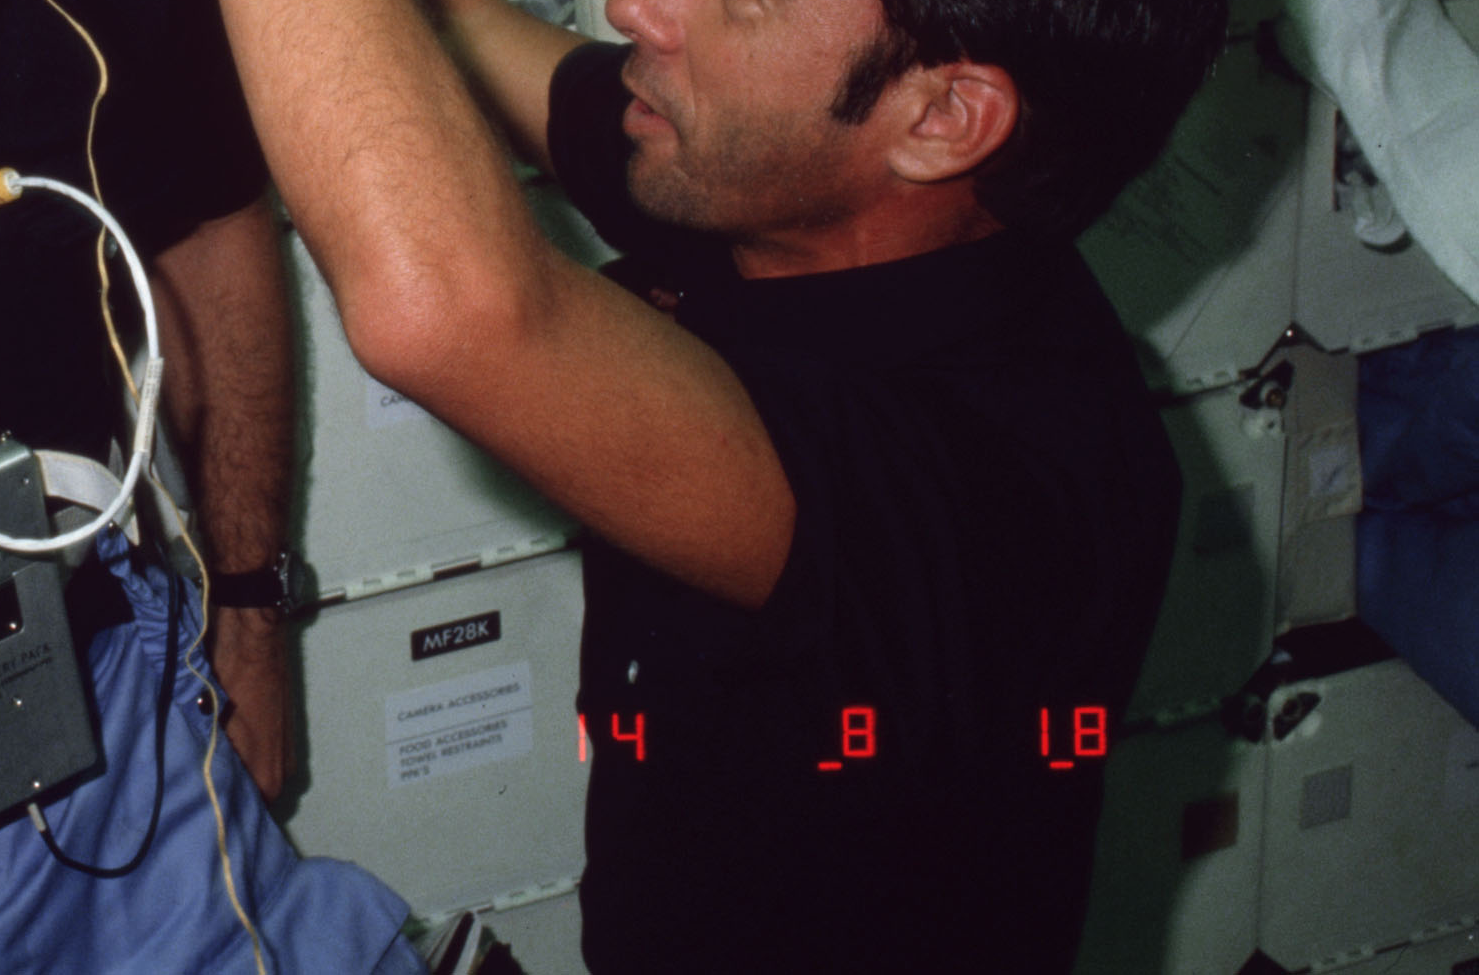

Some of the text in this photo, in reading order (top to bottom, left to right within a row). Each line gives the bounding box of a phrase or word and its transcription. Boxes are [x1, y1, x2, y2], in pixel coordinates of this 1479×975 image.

[422, 620, 489, 652] MF28K
[397, 682, 520, 722] CAMERA ACCESSORIES
[399, 720, 507, 755] FOOD ACCESSORIES
[440, 734, 503, 756] RESTRAINTS
